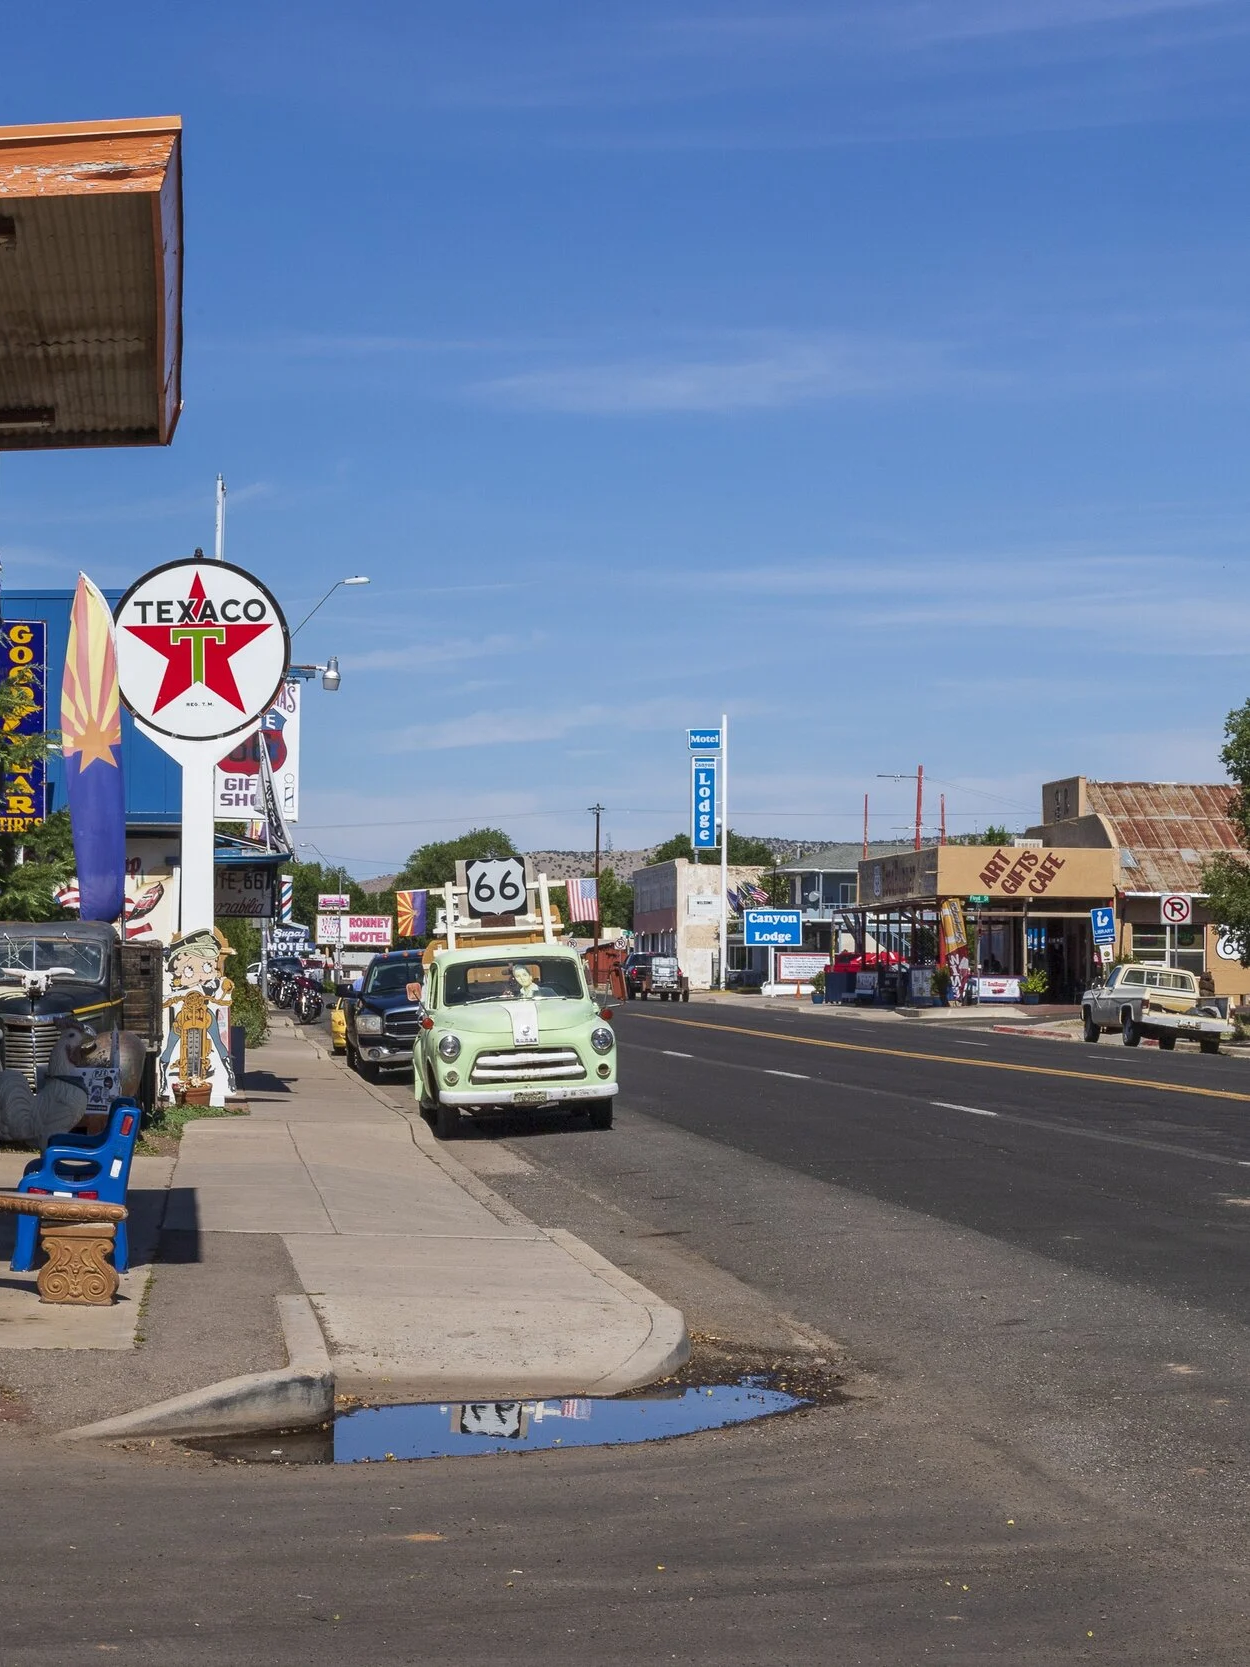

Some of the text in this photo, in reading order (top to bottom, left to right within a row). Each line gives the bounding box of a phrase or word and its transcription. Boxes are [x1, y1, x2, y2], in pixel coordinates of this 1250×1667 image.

[133, 598, 267, 624] TEXACO
[690, 735, 719, 744] Motel
[224, 777, 258, 791] GIF
[220, 793, 256, 807] SH
[698, 773, 711, 841] Lodge
[979, 849, 1011, 889] ART
[1000, 850, 1039, 895] GIFTS
[1028, 852, 1066, 894] CAFE
[474, 870, 520, 902] 66
[349, 917, 390, 928] ROMNEY
[748, 913, 797, 926] Canyon
[273, 928, 306, 941] Supai
[349, 931, 391, 943] MOTEL
[754, 931, 792, 943] Lodge
[267, 942, 312, 951] MOTEL
